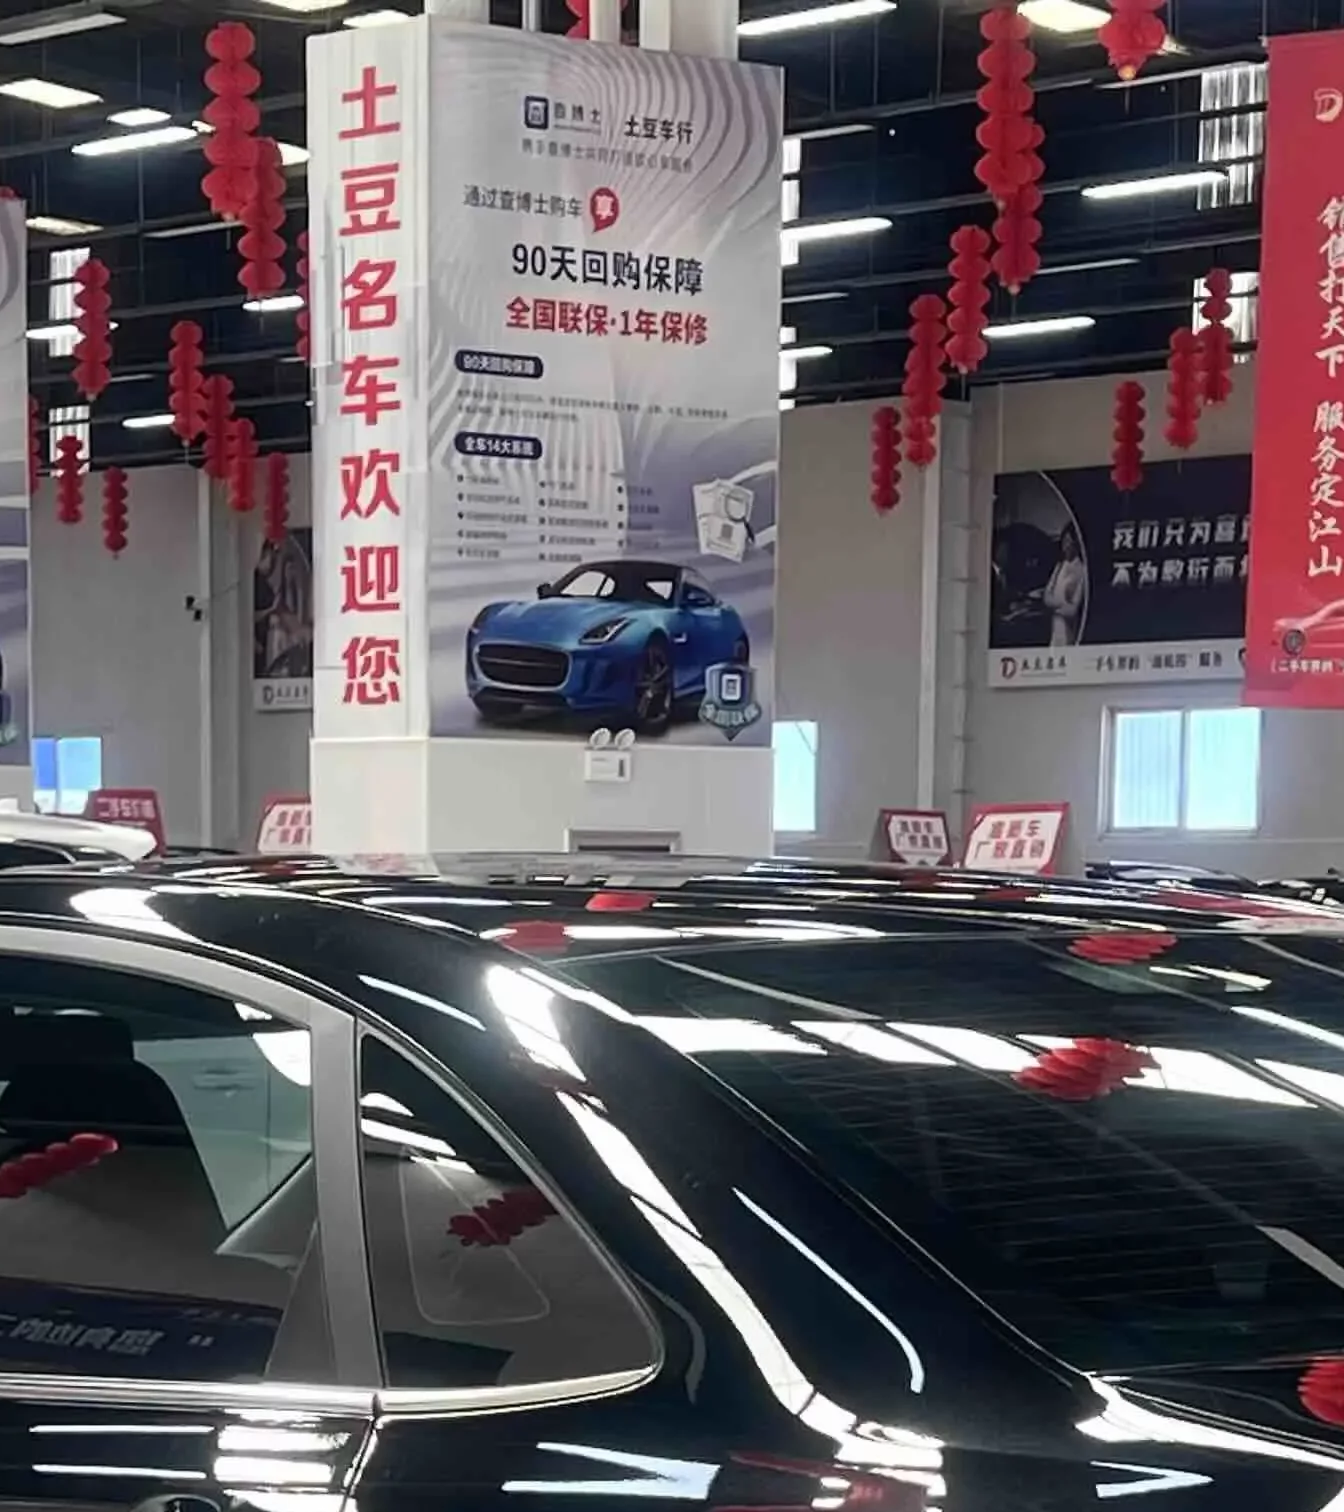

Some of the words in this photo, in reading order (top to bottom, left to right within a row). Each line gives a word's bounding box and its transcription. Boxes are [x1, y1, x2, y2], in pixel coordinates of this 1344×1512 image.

[624, 114, 694, 145] 土豆车行
[512, 244, 705, 297] 90天回购保障
[338, 65, 402, 706] 土豆名车欢迎您
